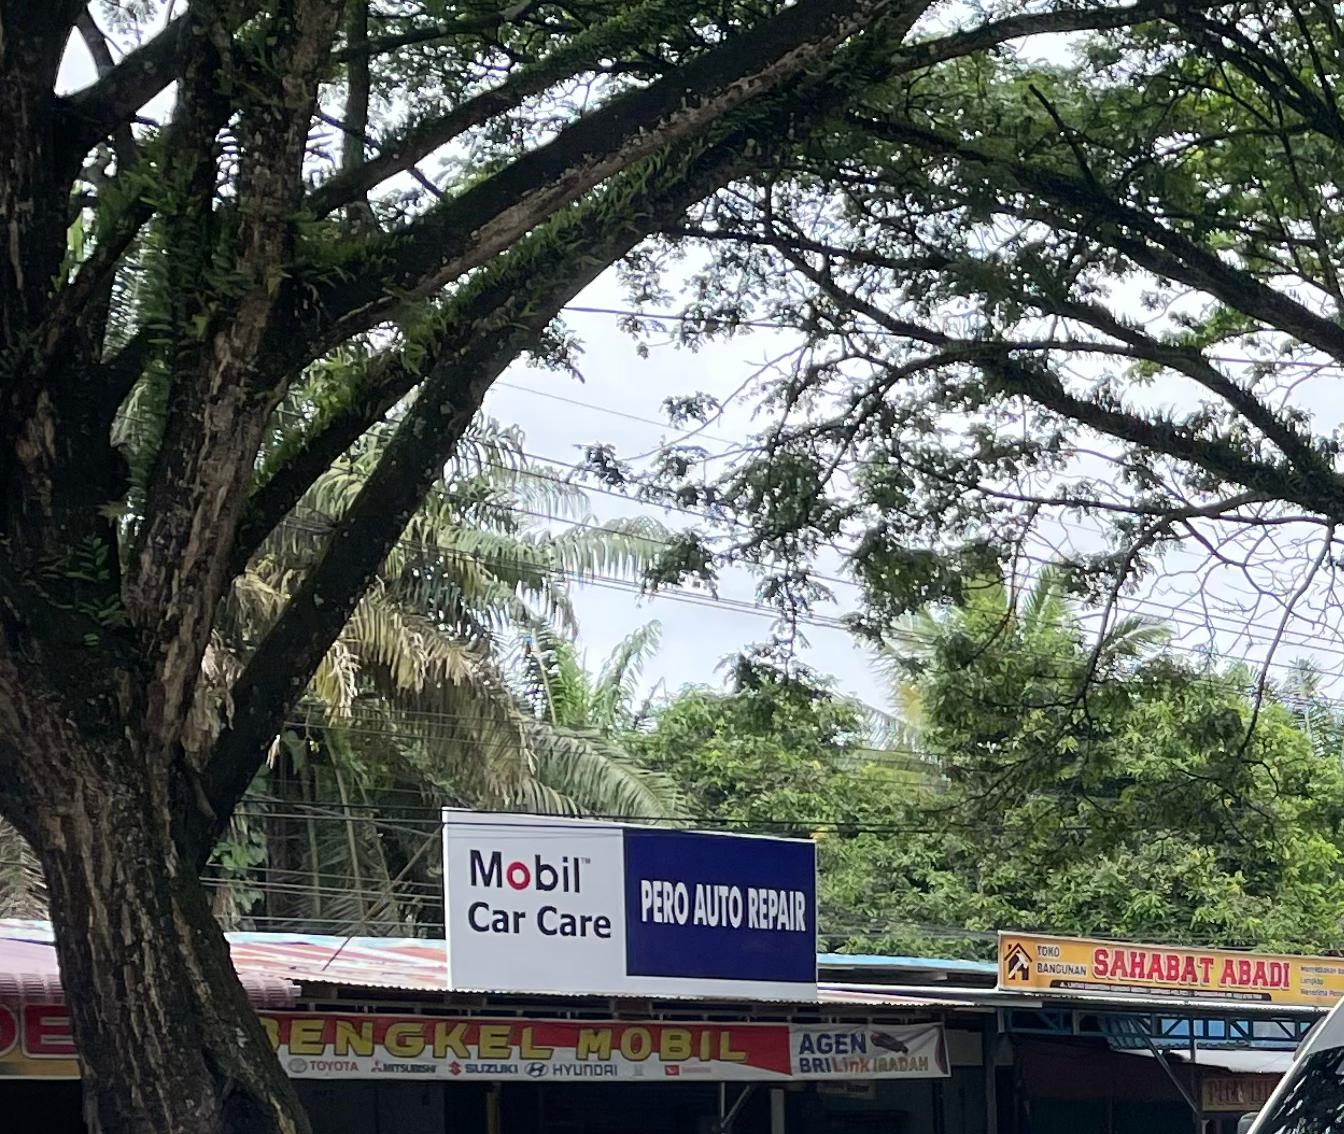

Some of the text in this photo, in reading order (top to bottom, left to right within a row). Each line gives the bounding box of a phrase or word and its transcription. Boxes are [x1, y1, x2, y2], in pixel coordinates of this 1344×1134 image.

[469, 849, 581, 893] Mobil
[468, 901, 612, 939] Car Care
[640, 879, 807, 932] PERO AUTO REPAIR
[1036, 945, 1060, 958] TOKO
[1036, 962, 1087, 976] BANGUNAN
[1093, 947, 1290, 988] SAHABAT ABADI
[575, 1026, 748, 1064] MOBIL
[798, 1032, 868, 1055] AGEN
[310, 1060, 360, 1072] TOYOTA
[465, 1064, 519, 1074] SUZUKI
[552, 1064, 618, 1077] HYUNDAI
